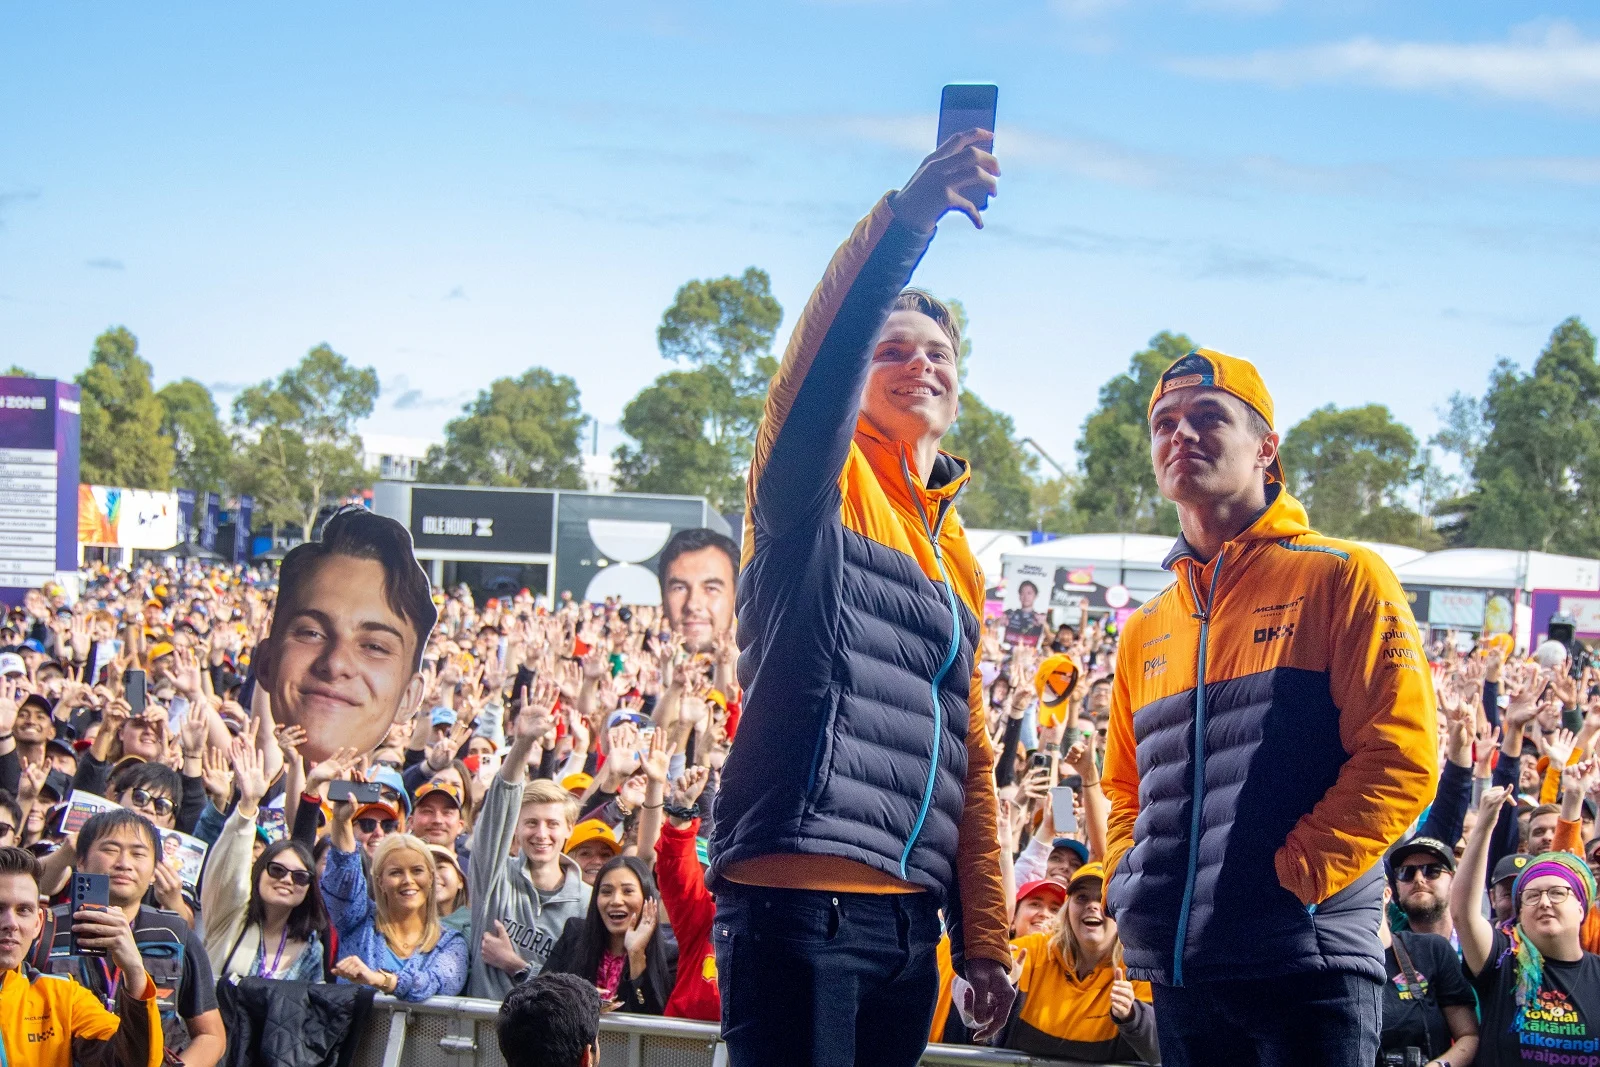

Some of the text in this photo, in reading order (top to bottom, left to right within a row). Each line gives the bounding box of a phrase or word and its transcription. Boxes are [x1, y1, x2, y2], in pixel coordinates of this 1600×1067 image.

[1142, 634, 1164, 649] android
[1143, 653, 1167, 673] DELL
[1519, 1032, 1600, 1053] kikorangi
